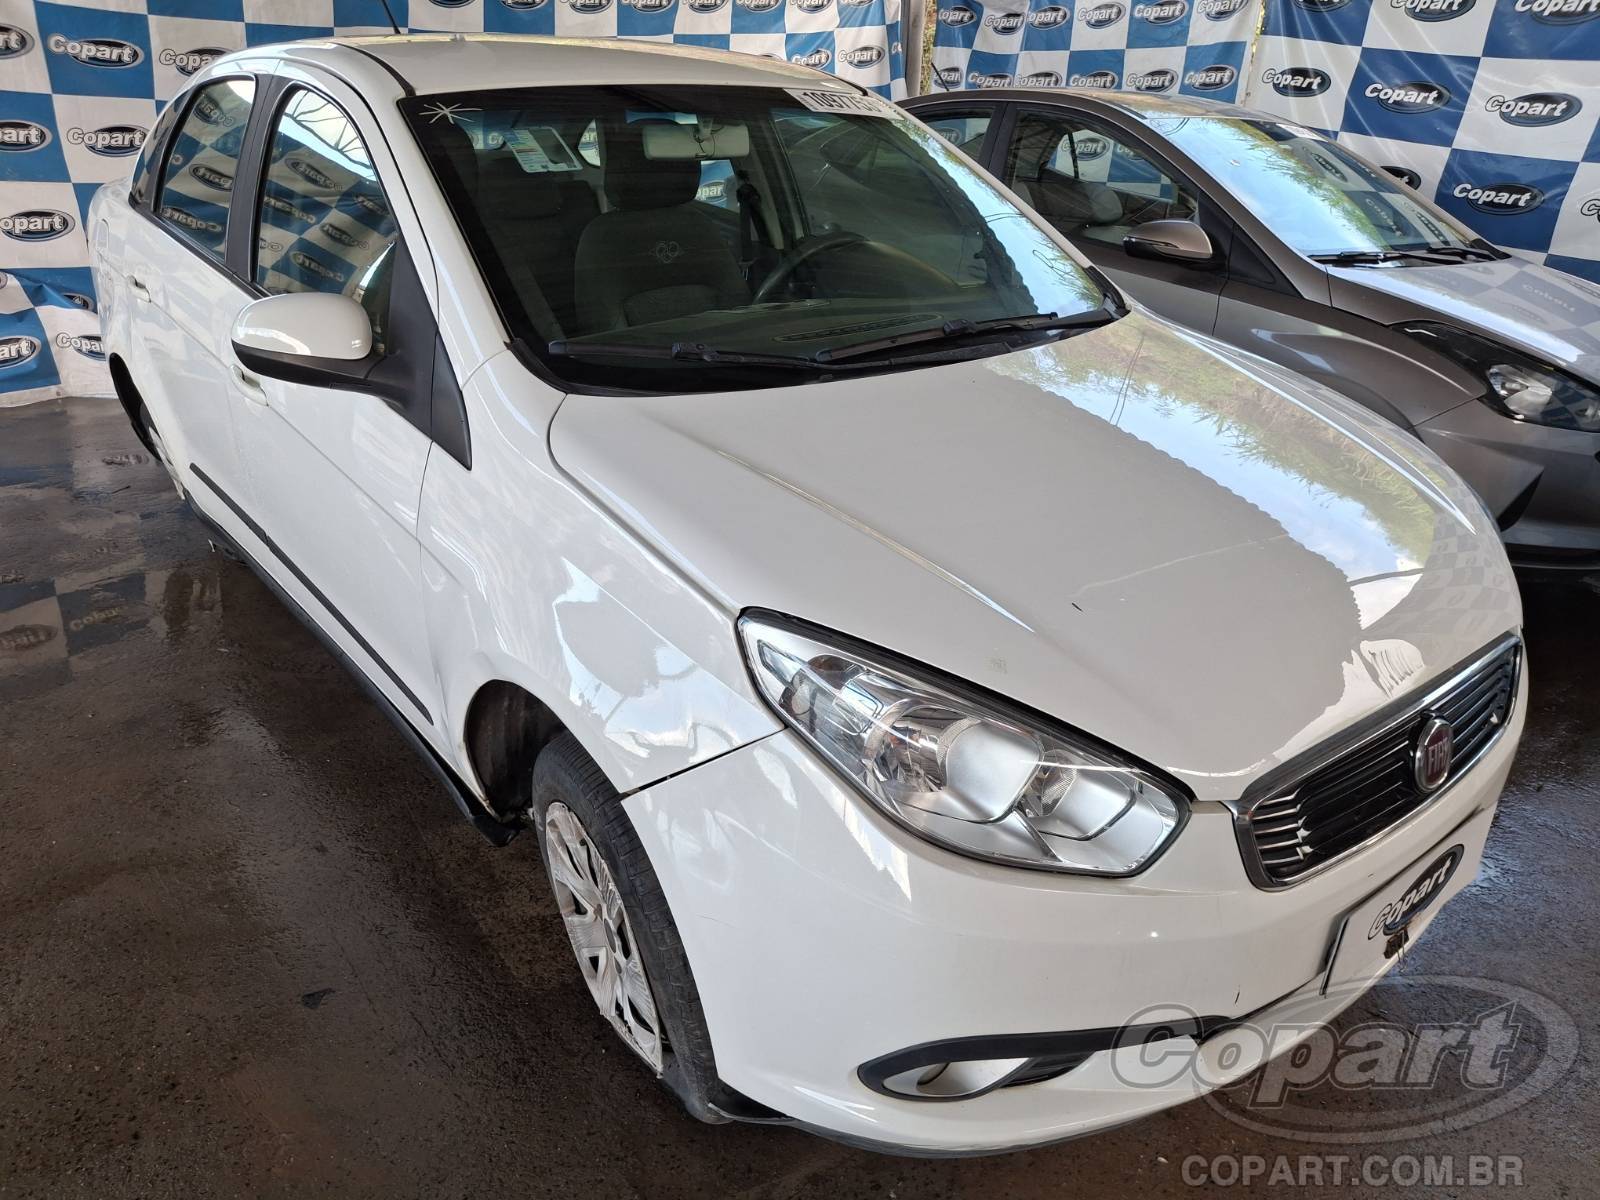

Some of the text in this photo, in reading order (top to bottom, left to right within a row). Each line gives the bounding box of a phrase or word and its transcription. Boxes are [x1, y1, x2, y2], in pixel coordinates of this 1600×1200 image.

[1028, 9, 1063, 25] opart
[1079, 6, 1117, 22] Copart
[1135, 2, 1184, 19] Copart
[49, 35, 132, 63] Copart
[839, 48, 879, 63] Copart
[159, 49, 221, 71] Copa
[1126, 72, 1171, 87] Copart
[1263, 69, 1322, 89] Copart
[1364, 83, 1439, 105] Copart
[1486, 95, 1569, 117] Copart
[67, 127, 145, 149] Copart
[1453, 183, 1532, 207] Copart
[0, 215, 64, 234] opart
[56, 332, 104, 352] Copa
[1368, 855, 1454, 940] Copart
